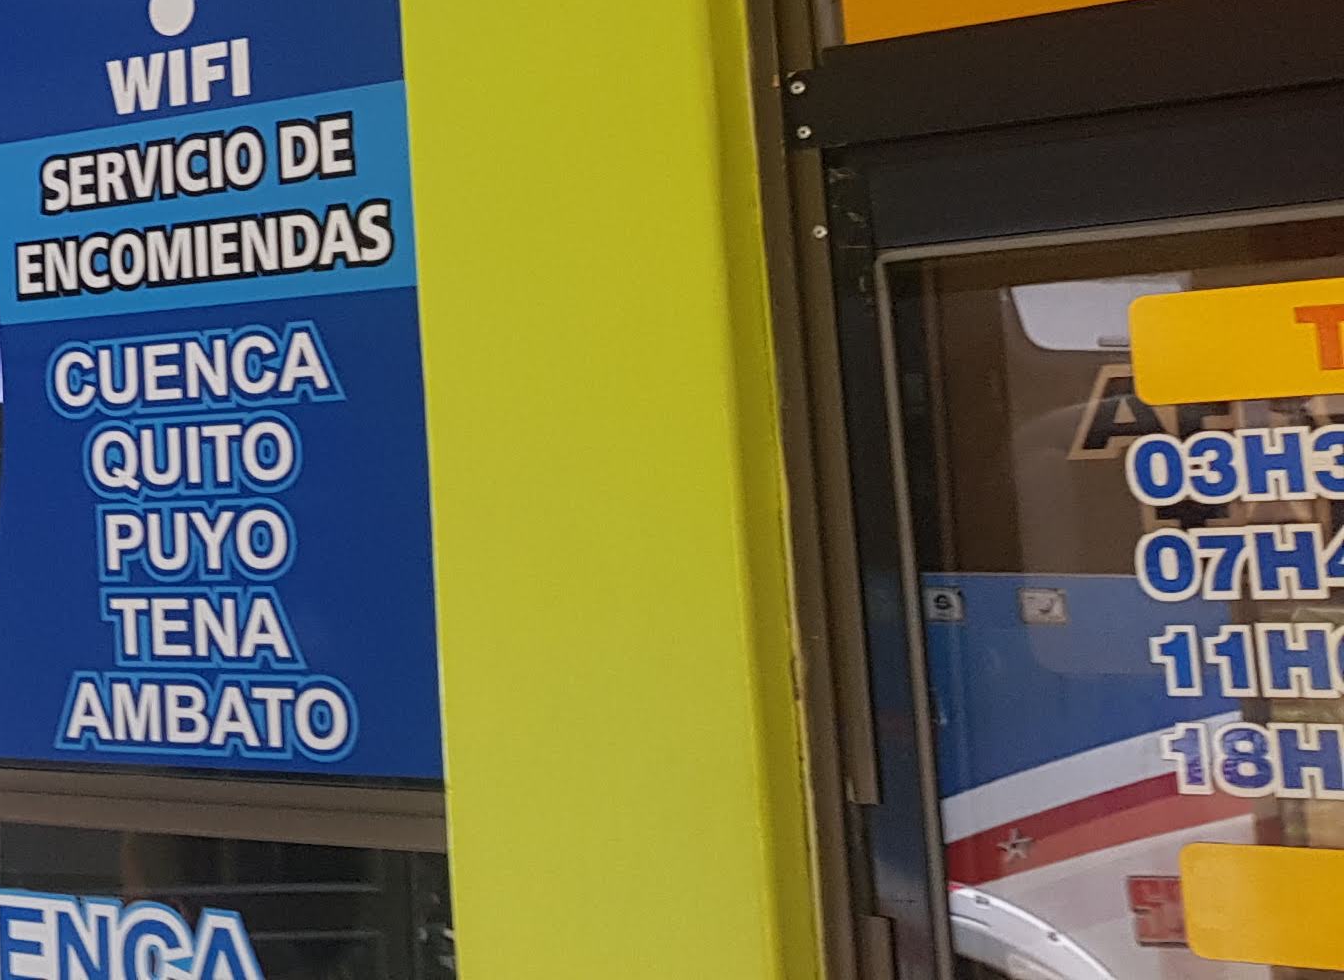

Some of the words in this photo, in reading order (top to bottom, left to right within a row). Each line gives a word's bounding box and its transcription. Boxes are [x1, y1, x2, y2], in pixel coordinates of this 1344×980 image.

[106, 38, 251, 115] WIFI
[42, 127, 265, 213] SERVICIO
[277, 117, 353, 181] DE
[17, 202, 393, 297] ENCOMIENDAS
[52, 328, 333, 408] CUENCA
[88, 417, 298, 493] QUITO
[102, 506, 291, 574] PUYO
[108, 595, 295, 660] TENA
[1154, 626, 1344, 694] 11H
[64, 680, 351, 753] AMBATO
